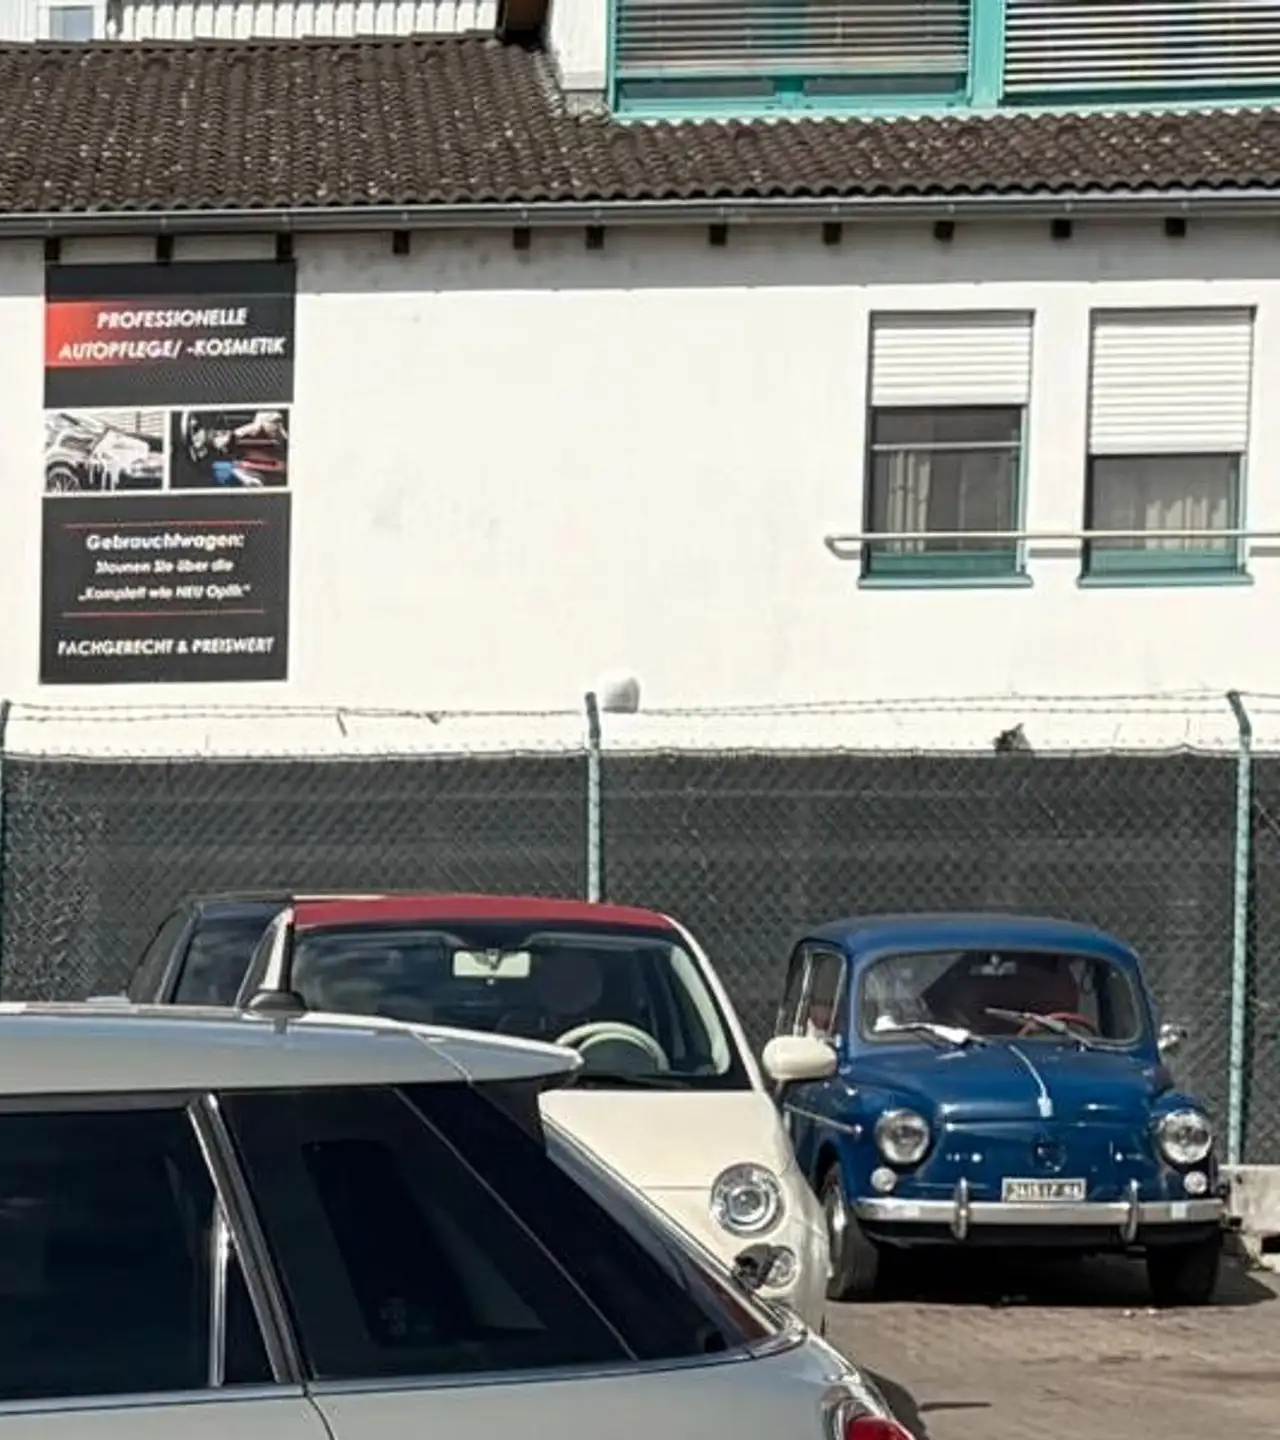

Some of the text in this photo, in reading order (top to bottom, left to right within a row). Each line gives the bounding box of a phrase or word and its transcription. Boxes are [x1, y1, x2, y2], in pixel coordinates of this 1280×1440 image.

[96, 307, 248, 330] PROFESSIONELLE
[187, 336, 287, 358] -KOSMETIK
[86, 533, 245, 552] Gebrauchtwagen:
[95, 557, 235, 574] Staunen Sie über die
[149, 586, 173, 600] wie
[175, 585, 204, 599] NEU
[57, 636, 275, 656] FACHGERECHT & PREISWERT
